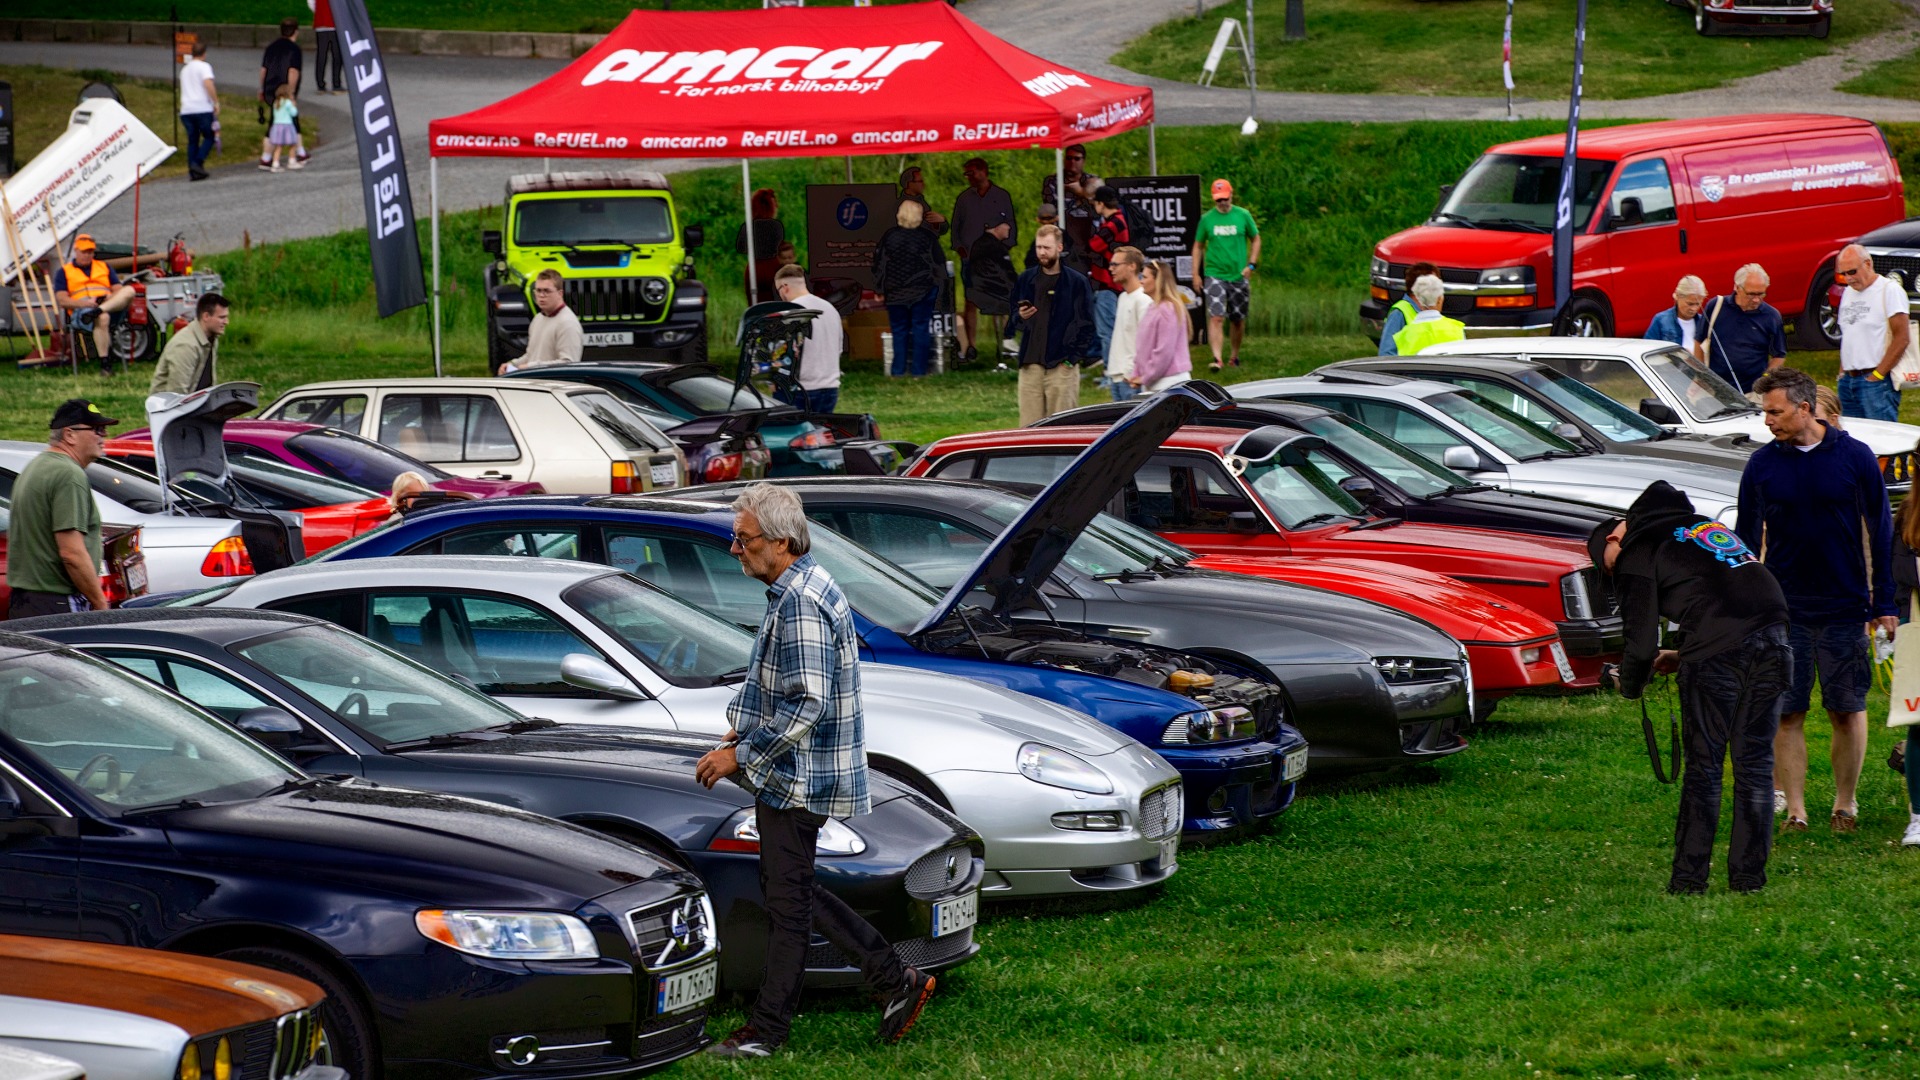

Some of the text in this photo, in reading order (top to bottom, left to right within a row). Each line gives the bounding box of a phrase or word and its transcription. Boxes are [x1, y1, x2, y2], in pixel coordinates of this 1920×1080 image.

[581, 41, 944, 86] amcar
[675, 85, 713, 97] For
[714, 79, 775, 95] norsk
[778, 78, 884, 94] bilhobby!
[436, 122, 1050, 149] amcar.no ReFUEL.no amcar.no ReFUEL.no amcar.no ReFUEL.no
[1728, 175, 1742, 185] En
[587, 334, 625, 344] AMCAR
[667, 978, 682, 1008] AA
[686, 967, 715, 1002] 75675
